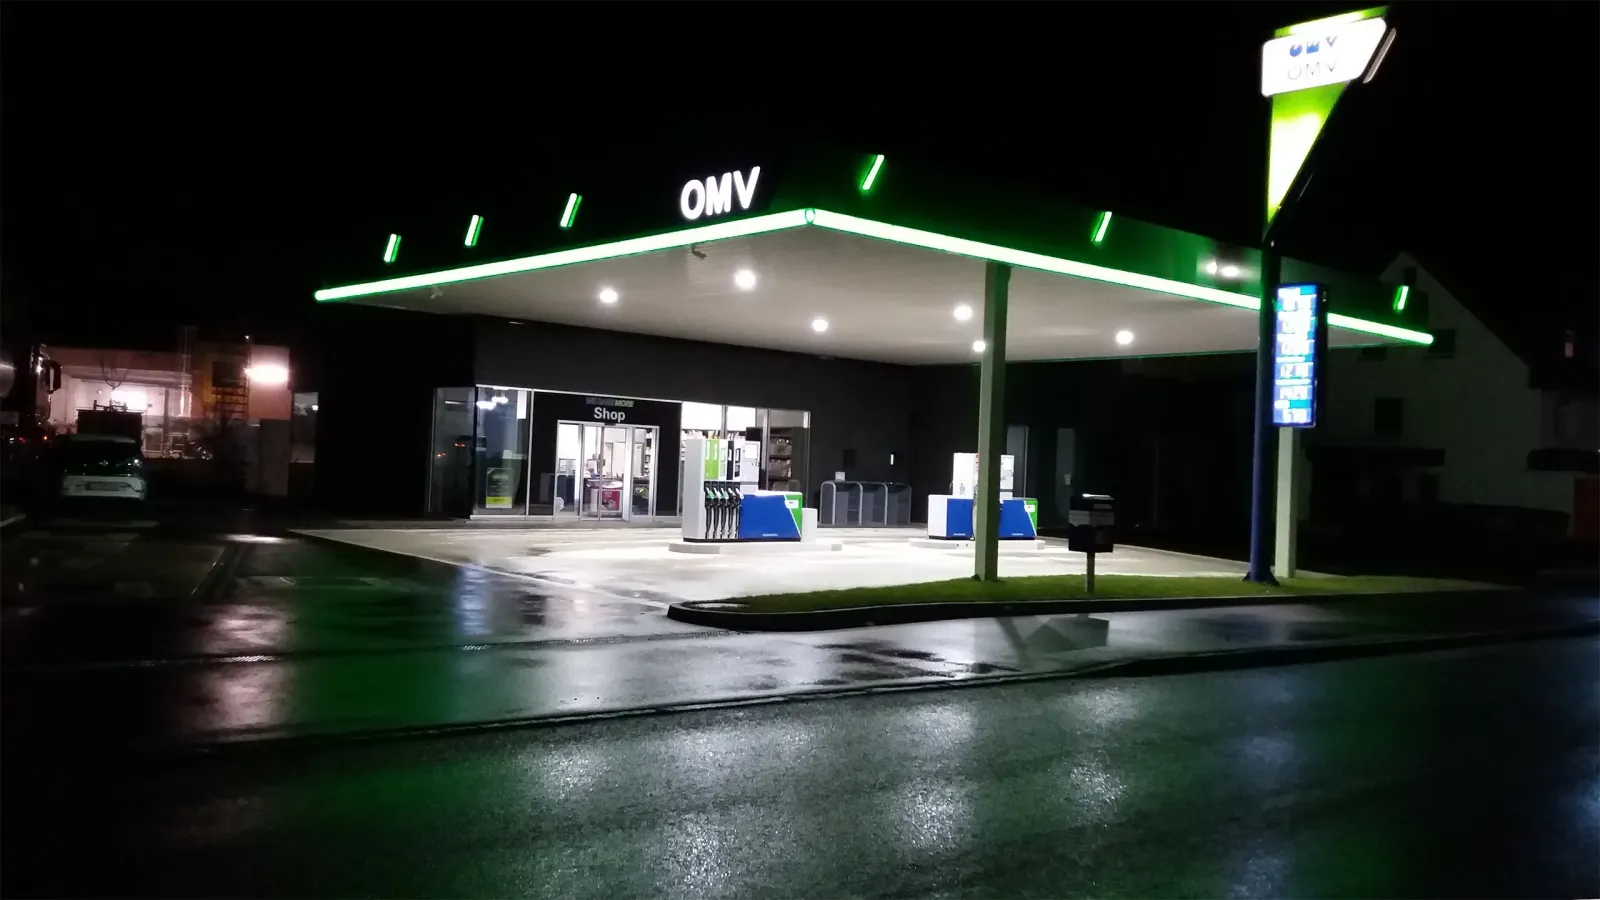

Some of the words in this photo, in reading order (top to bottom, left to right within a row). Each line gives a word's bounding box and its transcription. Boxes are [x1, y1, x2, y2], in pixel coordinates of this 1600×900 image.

[1289, 36, 1338, 57] OMV
[680, 166, 761, 220] OMV
[593, 407, 626, 423] Shop
